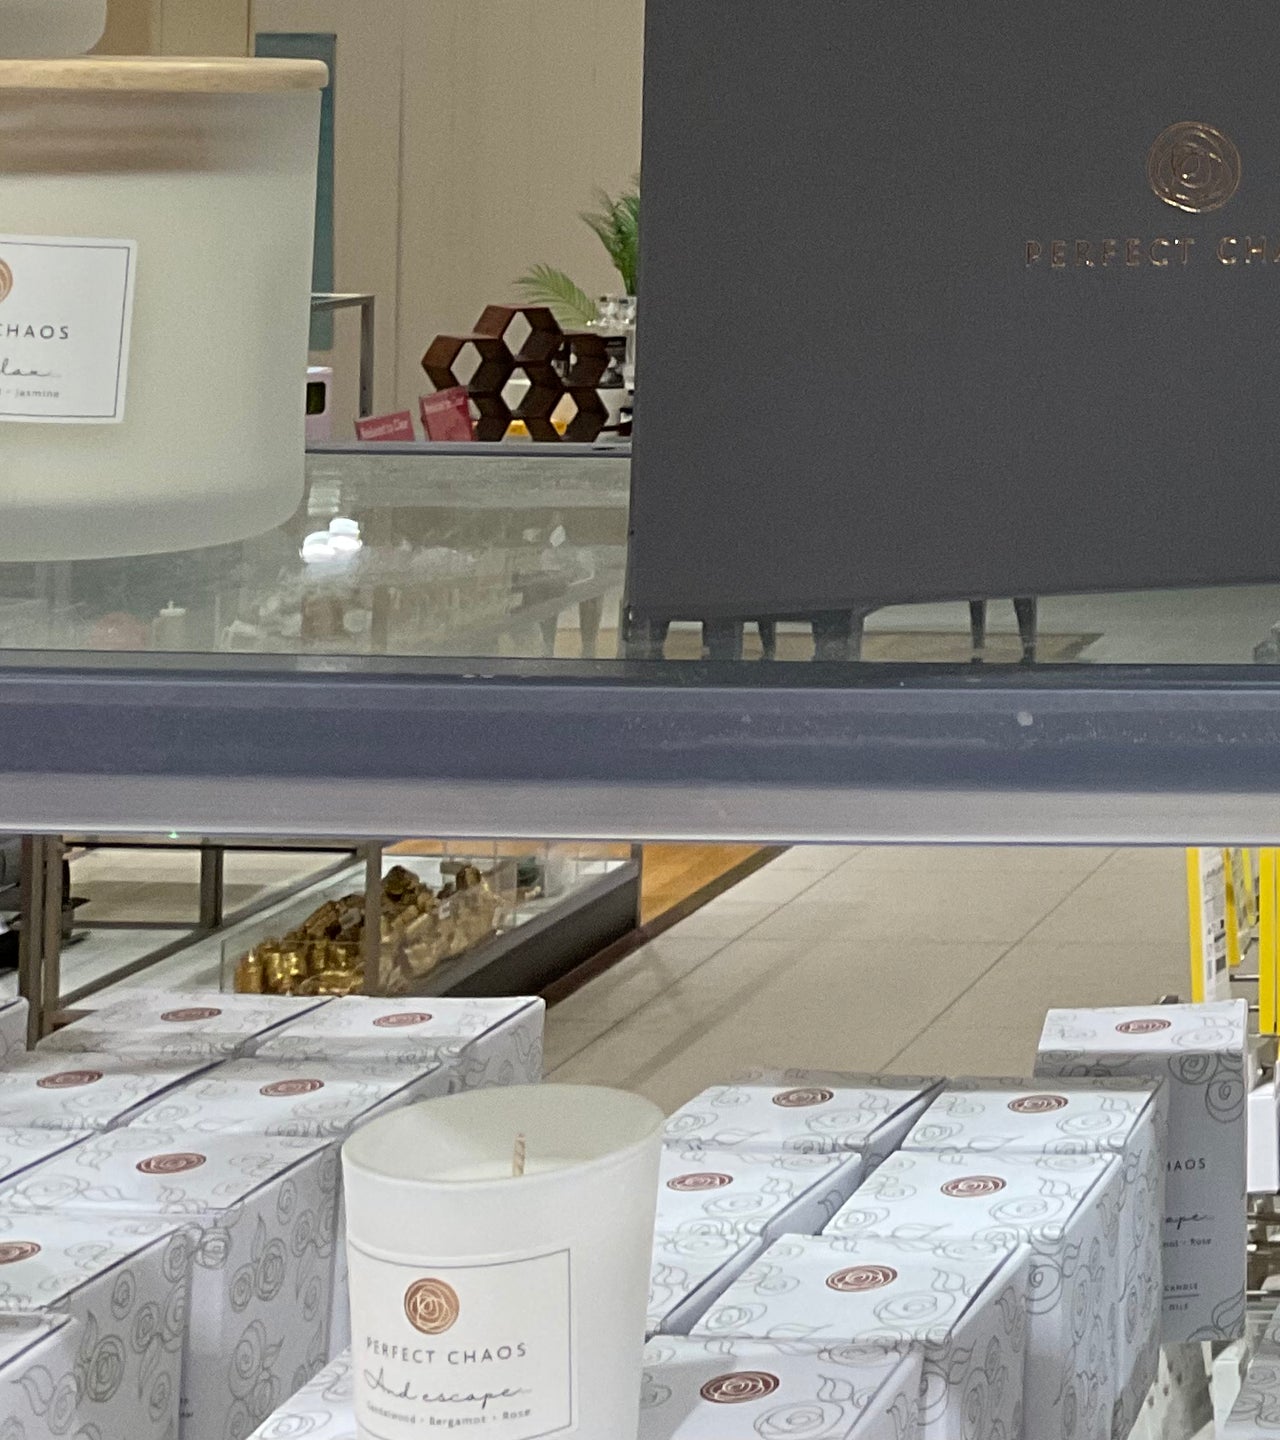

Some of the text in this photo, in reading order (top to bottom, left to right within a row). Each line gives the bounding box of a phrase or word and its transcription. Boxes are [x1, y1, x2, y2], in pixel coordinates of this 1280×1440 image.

[1024, 236, 1195, 268] PERFECT
[0, 323, 70, 340] HAOS
[366, 1336, 527, 1365] PERFECT CHAOS
[421, 1386, 532, 1410] escape
[501, 1408, 532, 1421] Rose
